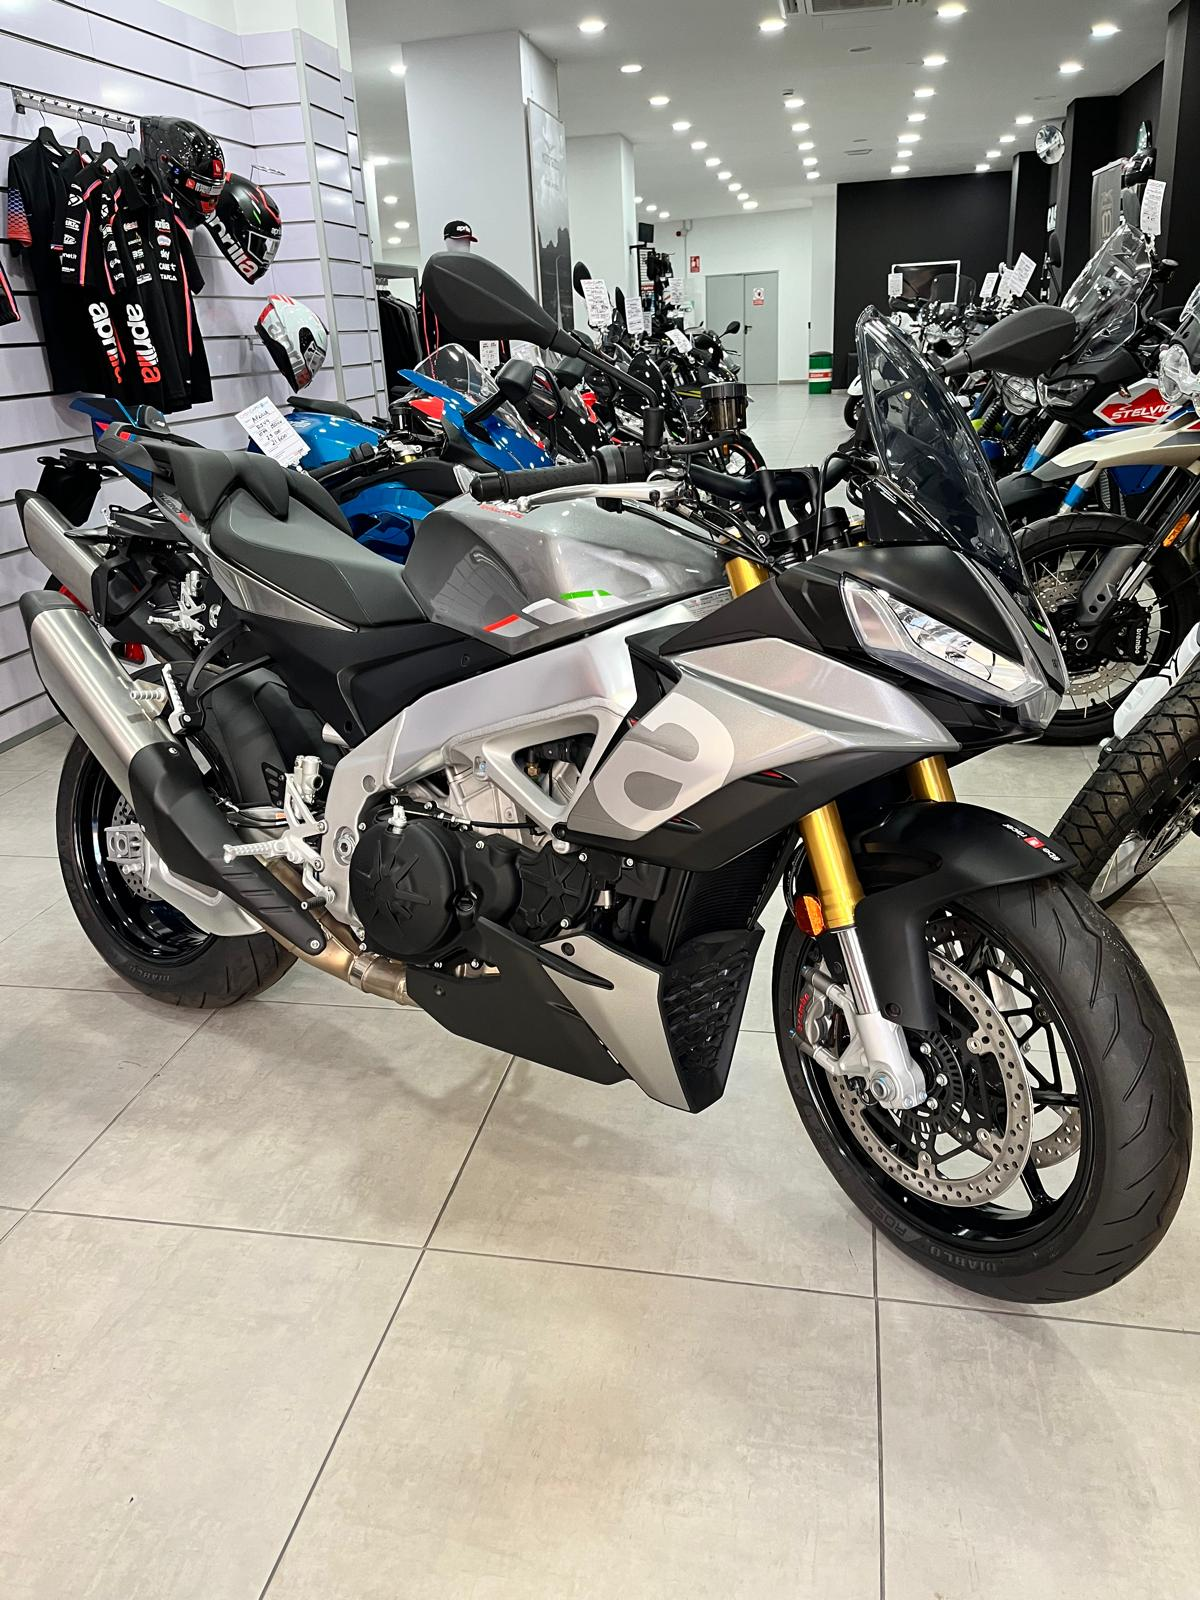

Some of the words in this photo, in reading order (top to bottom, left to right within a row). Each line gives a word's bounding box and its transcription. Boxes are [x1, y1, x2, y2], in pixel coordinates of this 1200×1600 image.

[126, 304, 161, 384] aprilia
[1111, 404, 1173, 419] STELVIO
[1135, 629, 1143, 654] brembo
